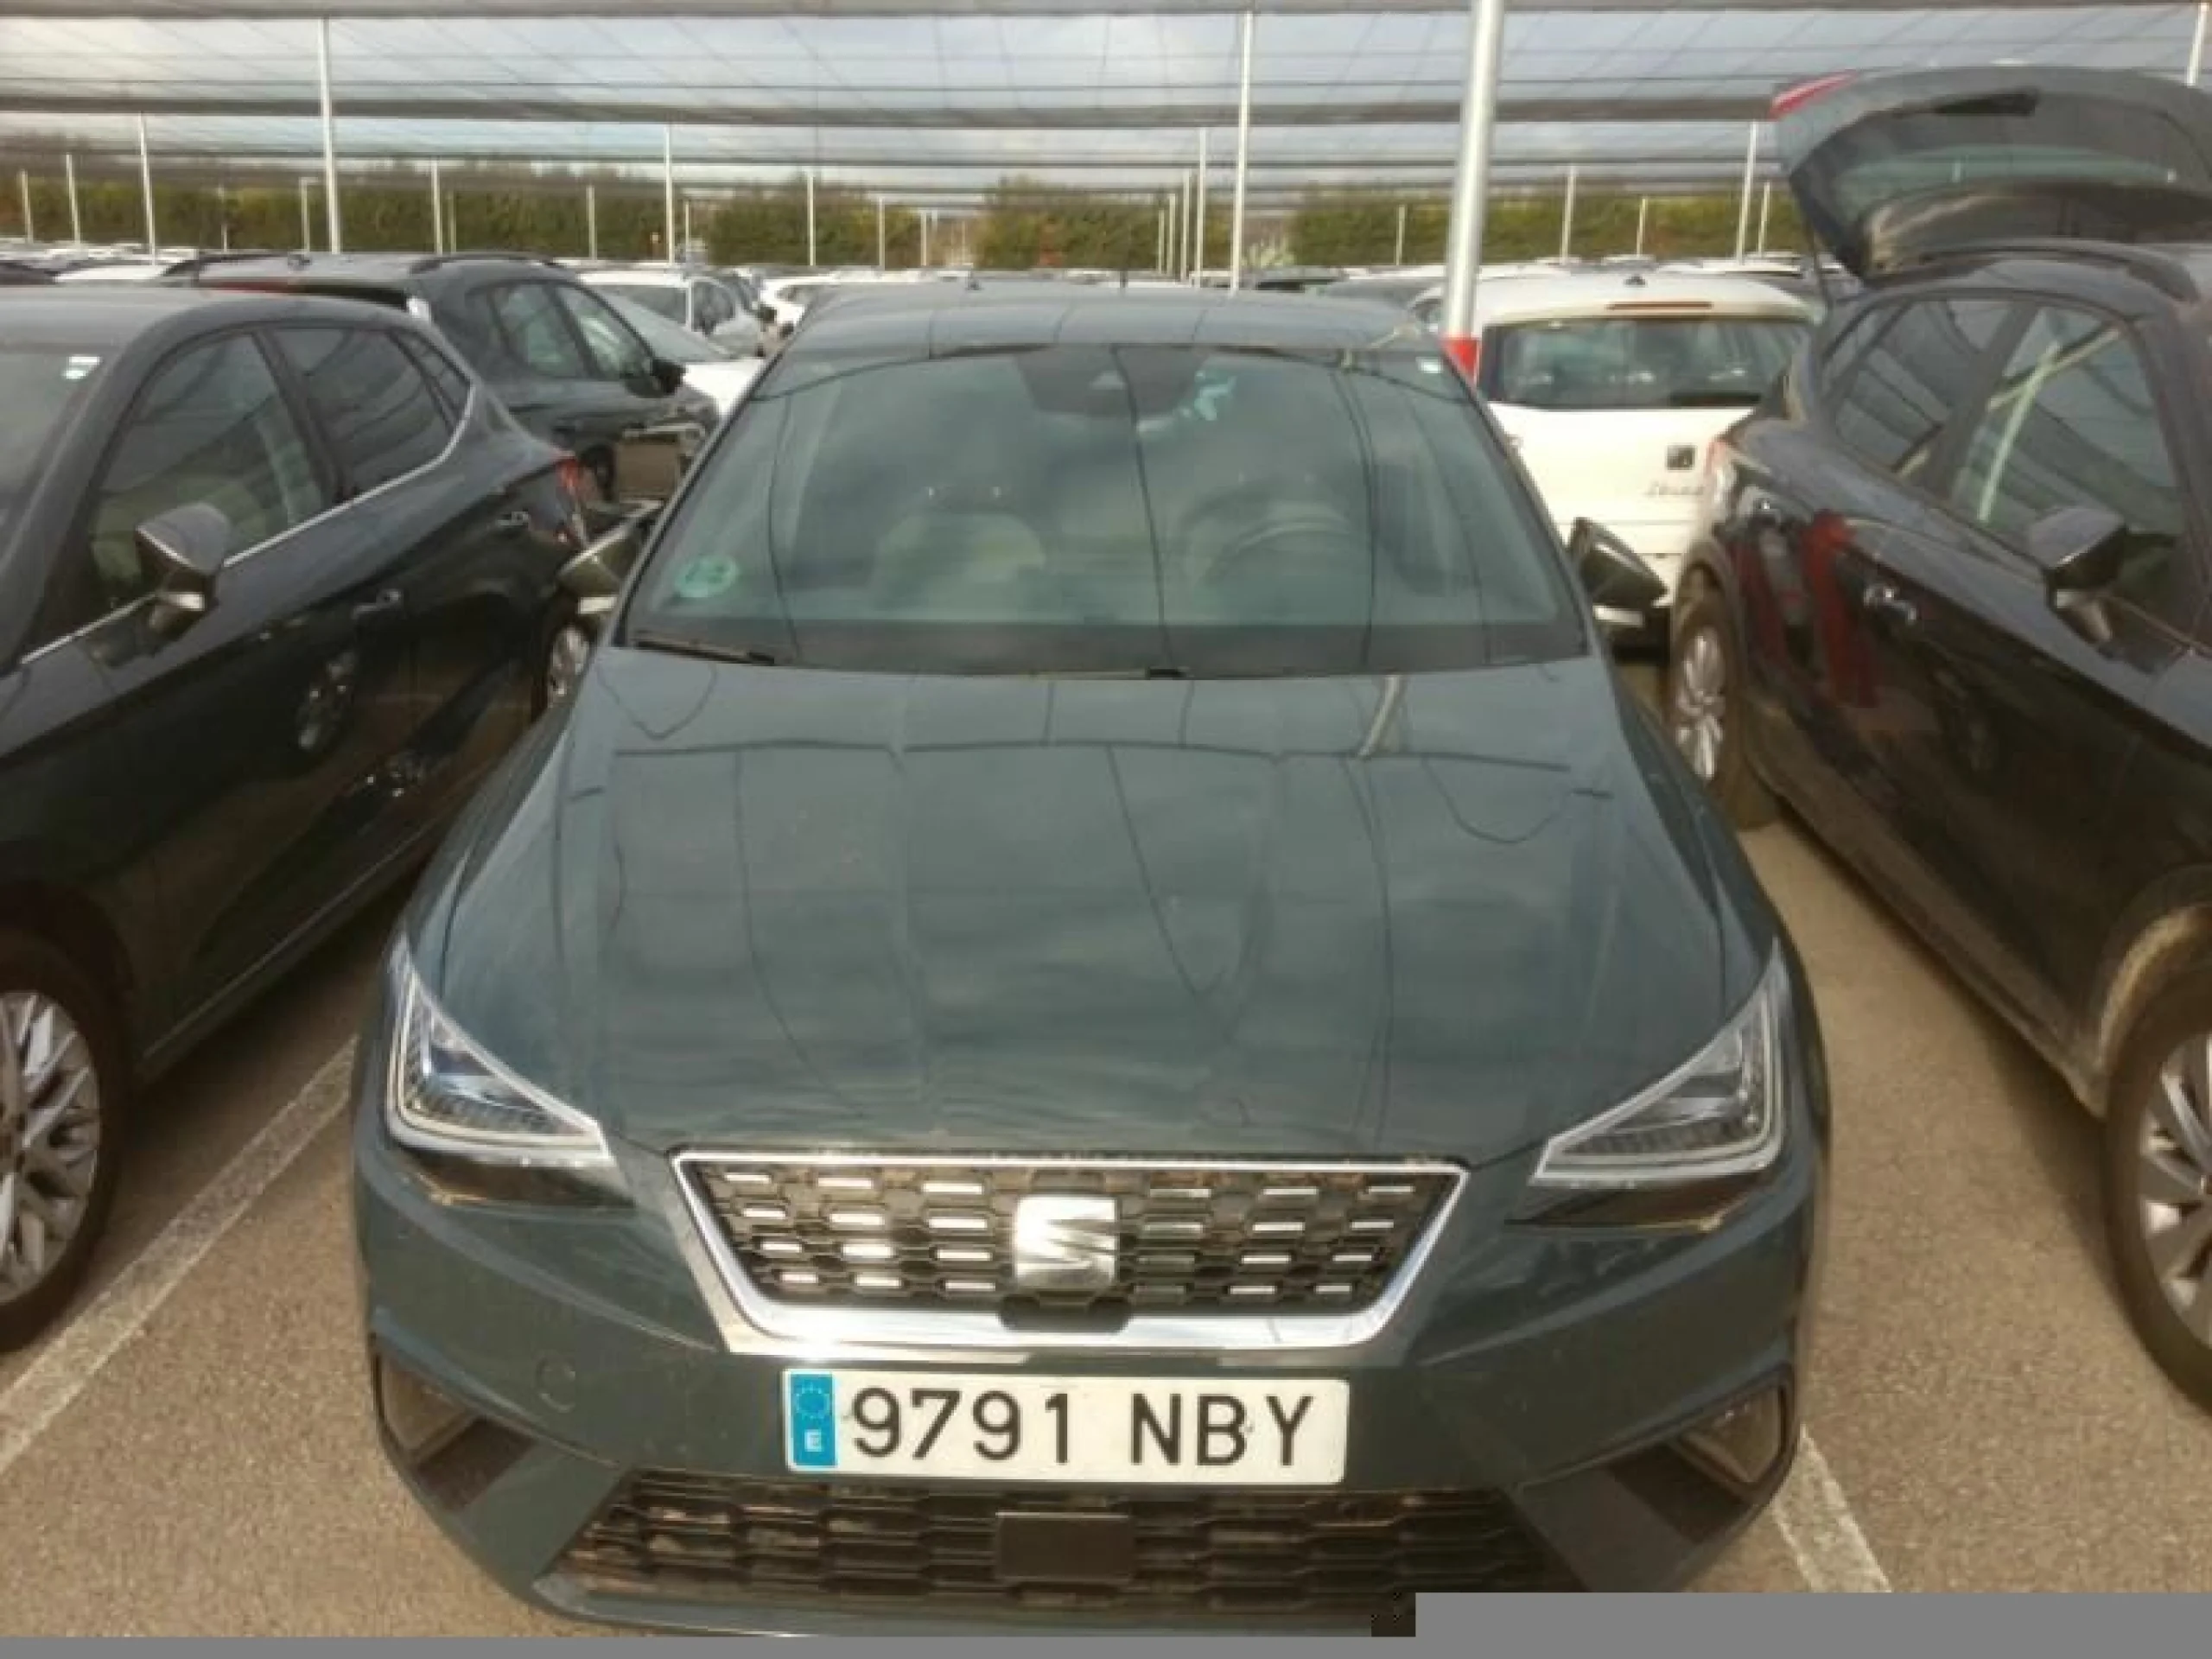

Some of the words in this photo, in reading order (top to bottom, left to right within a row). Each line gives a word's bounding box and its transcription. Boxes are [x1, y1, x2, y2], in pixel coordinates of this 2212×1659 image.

[804, 1429, 822, 1452] E
[852, 1387, 1069, 1464] 9791
[1130, 1393, 1314, 1466] NBY
